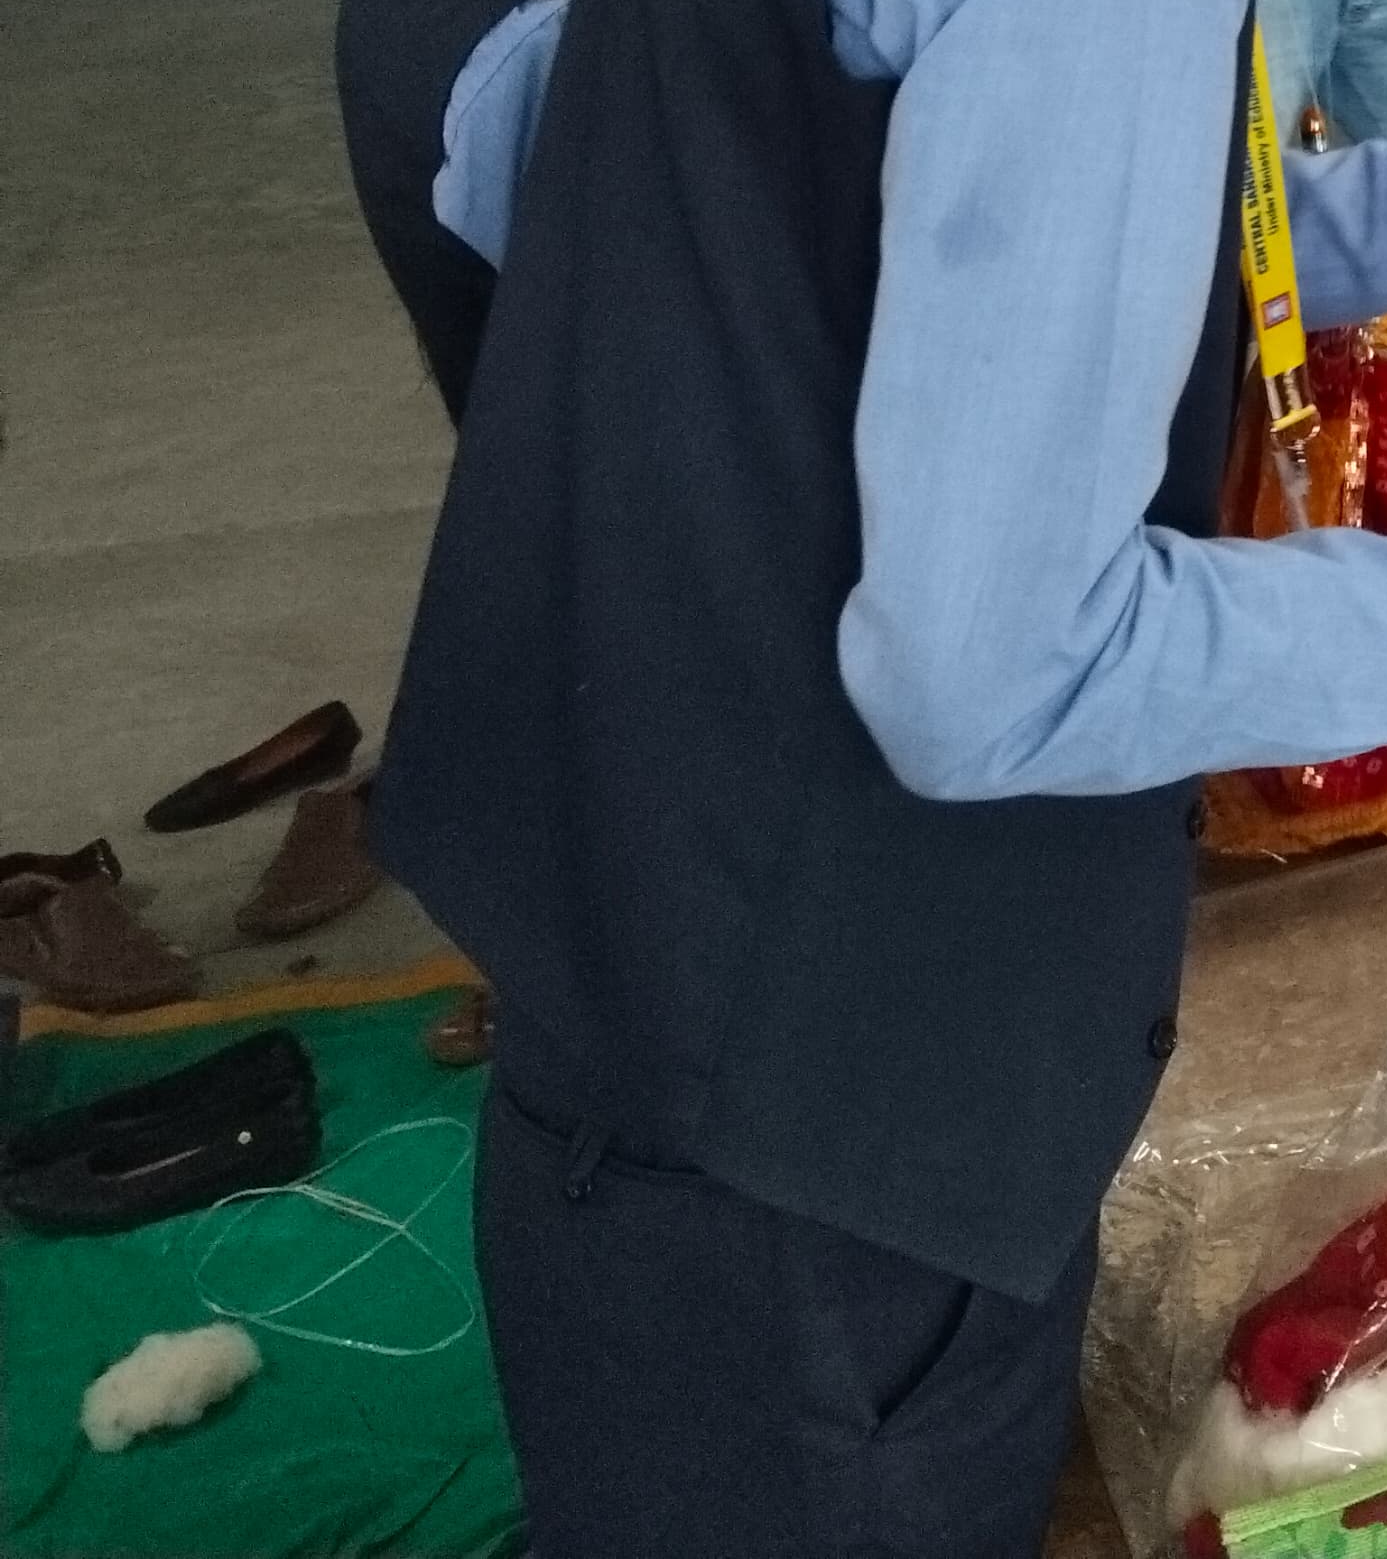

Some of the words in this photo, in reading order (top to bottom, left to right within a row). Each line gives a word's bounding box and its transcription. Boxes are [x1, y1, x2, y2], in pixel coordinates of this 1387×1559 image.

[1252, 126, 1267, 139] of
[1257, 143, 1273, 194] Ministry
[1266, 197, 1279, 236] Under
[1249, 211, 1269, 275] CENTRAL
